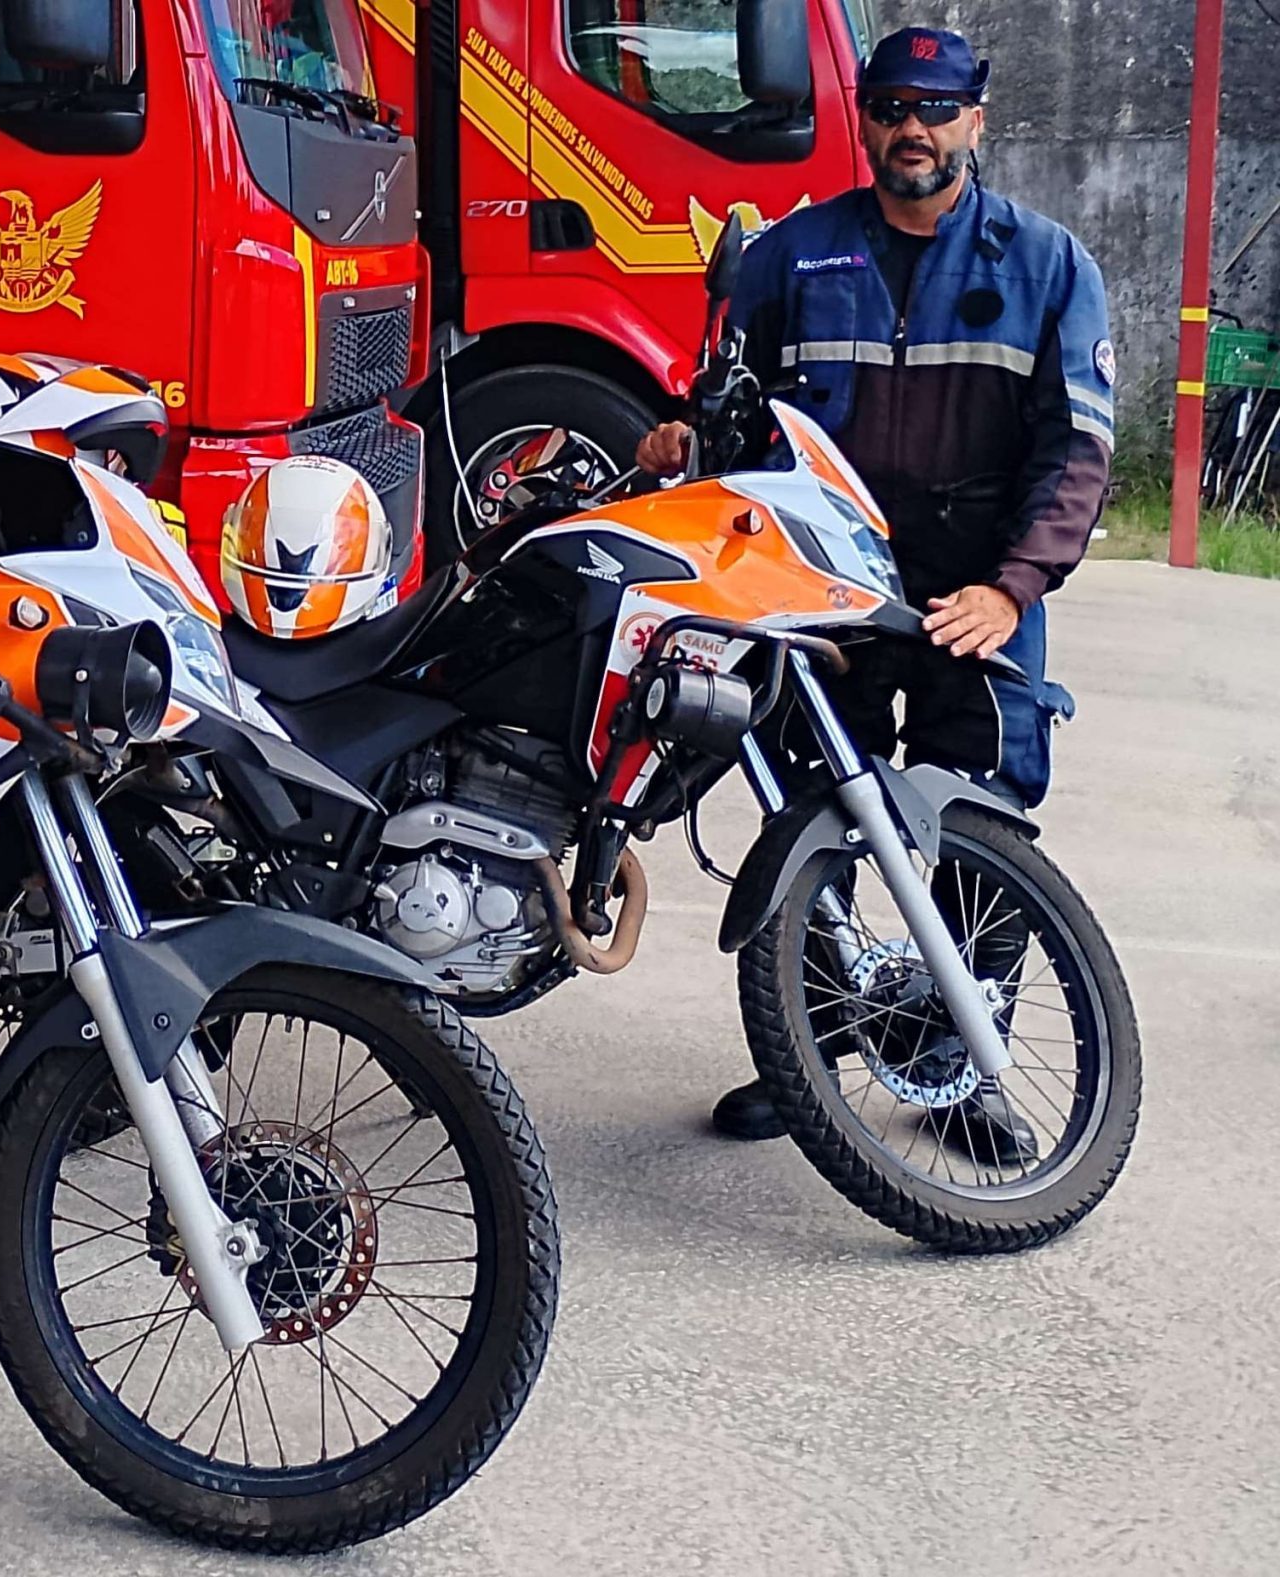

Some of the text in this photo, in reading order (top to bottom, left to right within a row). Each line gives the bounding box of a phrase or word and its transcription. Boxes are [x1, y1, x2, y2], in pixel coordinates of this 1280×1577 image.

[465, 27, 655, 220] SUA TAXA DE BOMBEIROS SALVANDO VIDAS
[466, 200, 528, 217] 270
[325, 257, 359, 286] ABT-16
[577, 565, 621, 585] HONDA
[683, 634, 725, 655] SAMU
